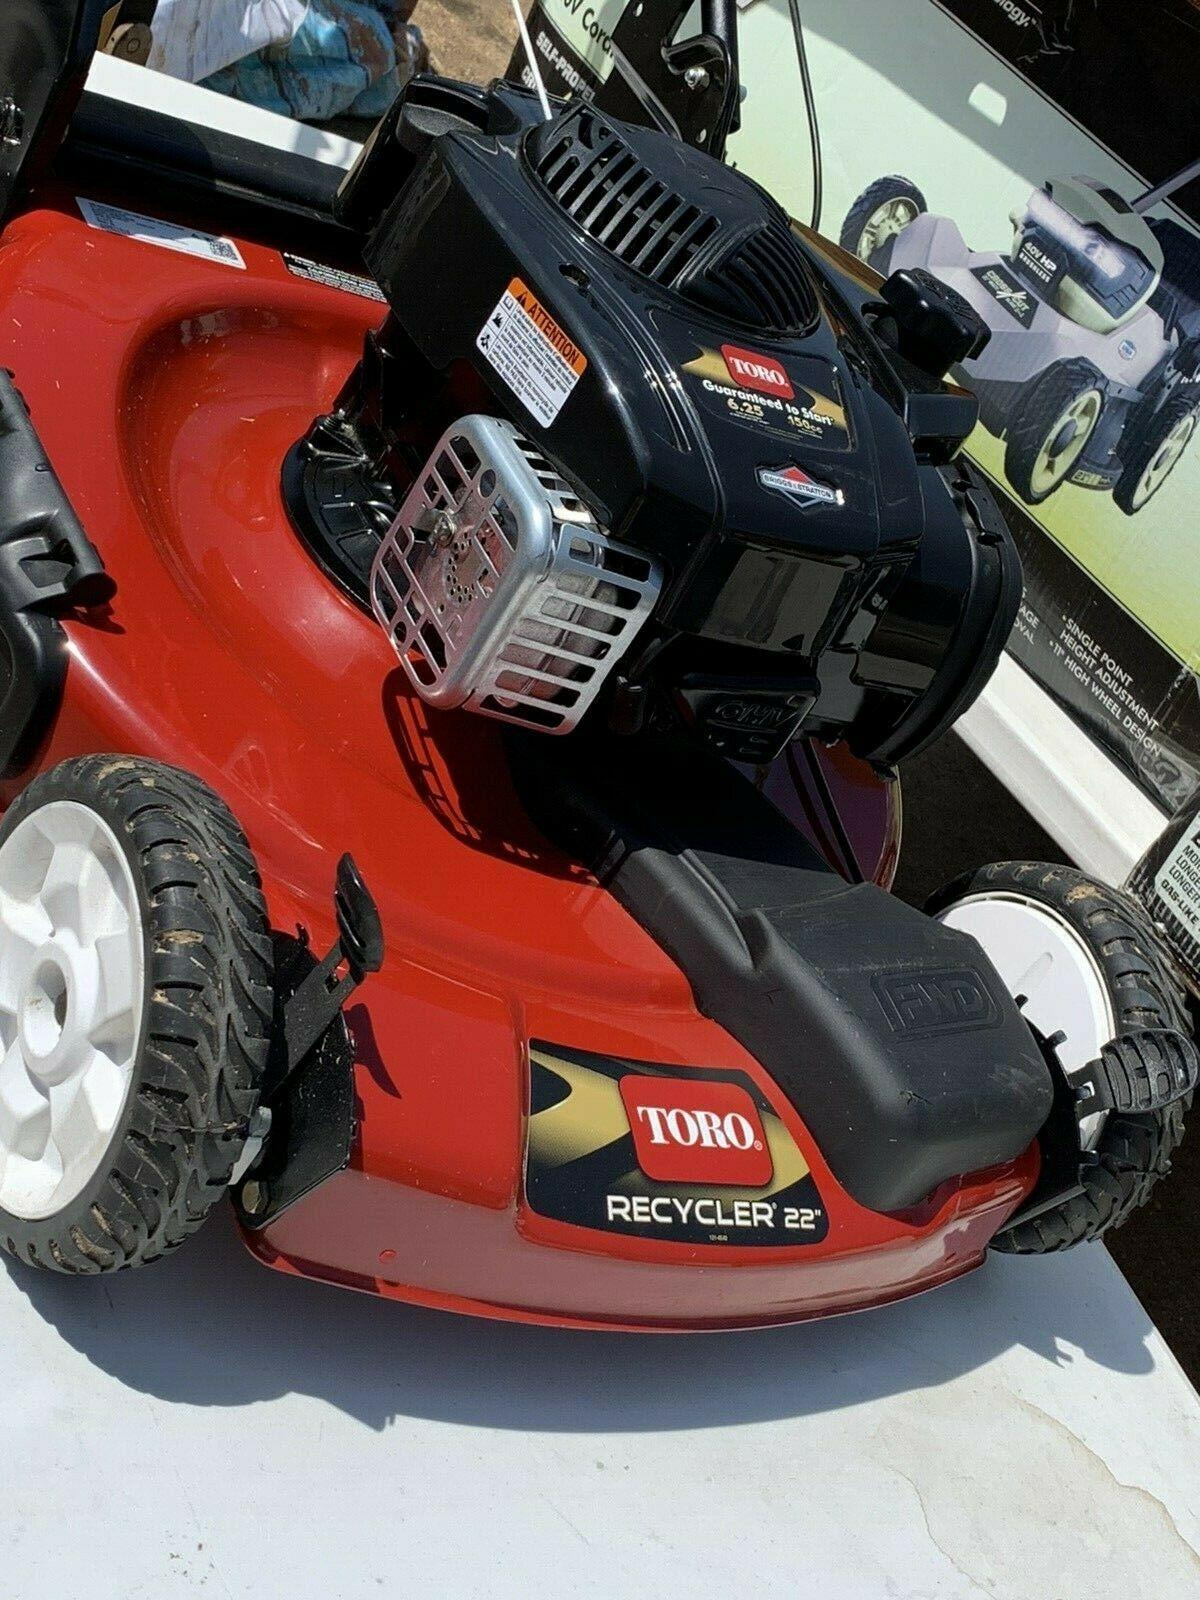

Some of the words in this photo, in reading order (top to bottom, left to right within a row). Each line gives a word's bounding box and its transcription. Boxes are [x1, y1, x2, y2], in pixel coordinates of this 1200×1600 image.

[1025, 242, 1042, 259] 40V
[1040, 255, 1057, 271] HP
[527, 303, 580, 366] ATTENTION
[729, 356, 787, 386] TORO
[702, 379, 783, 411] Guaranteed
[785, 403, 799, 415] to
[727, 398, 764, 417] 6.25
[787, 415, 823, 434] 150cc
[1066, 617, 1101, 657] SINGLE
[1100, 652, 1134, 687] POINT
[1060, 630, 1096, 668] HEIGHT
[1095, 667, 1158, 731] ADJUSTMENT
[1064, 655, 1091, 686] HIGH
[1090, 681, 1122, 720] WHEEL
[1122, 715, 1161, 757] DESIGN
[1161, 878, 1200, 924] GAS-LIKE
[784, 1207, 821, 1229] 22"
